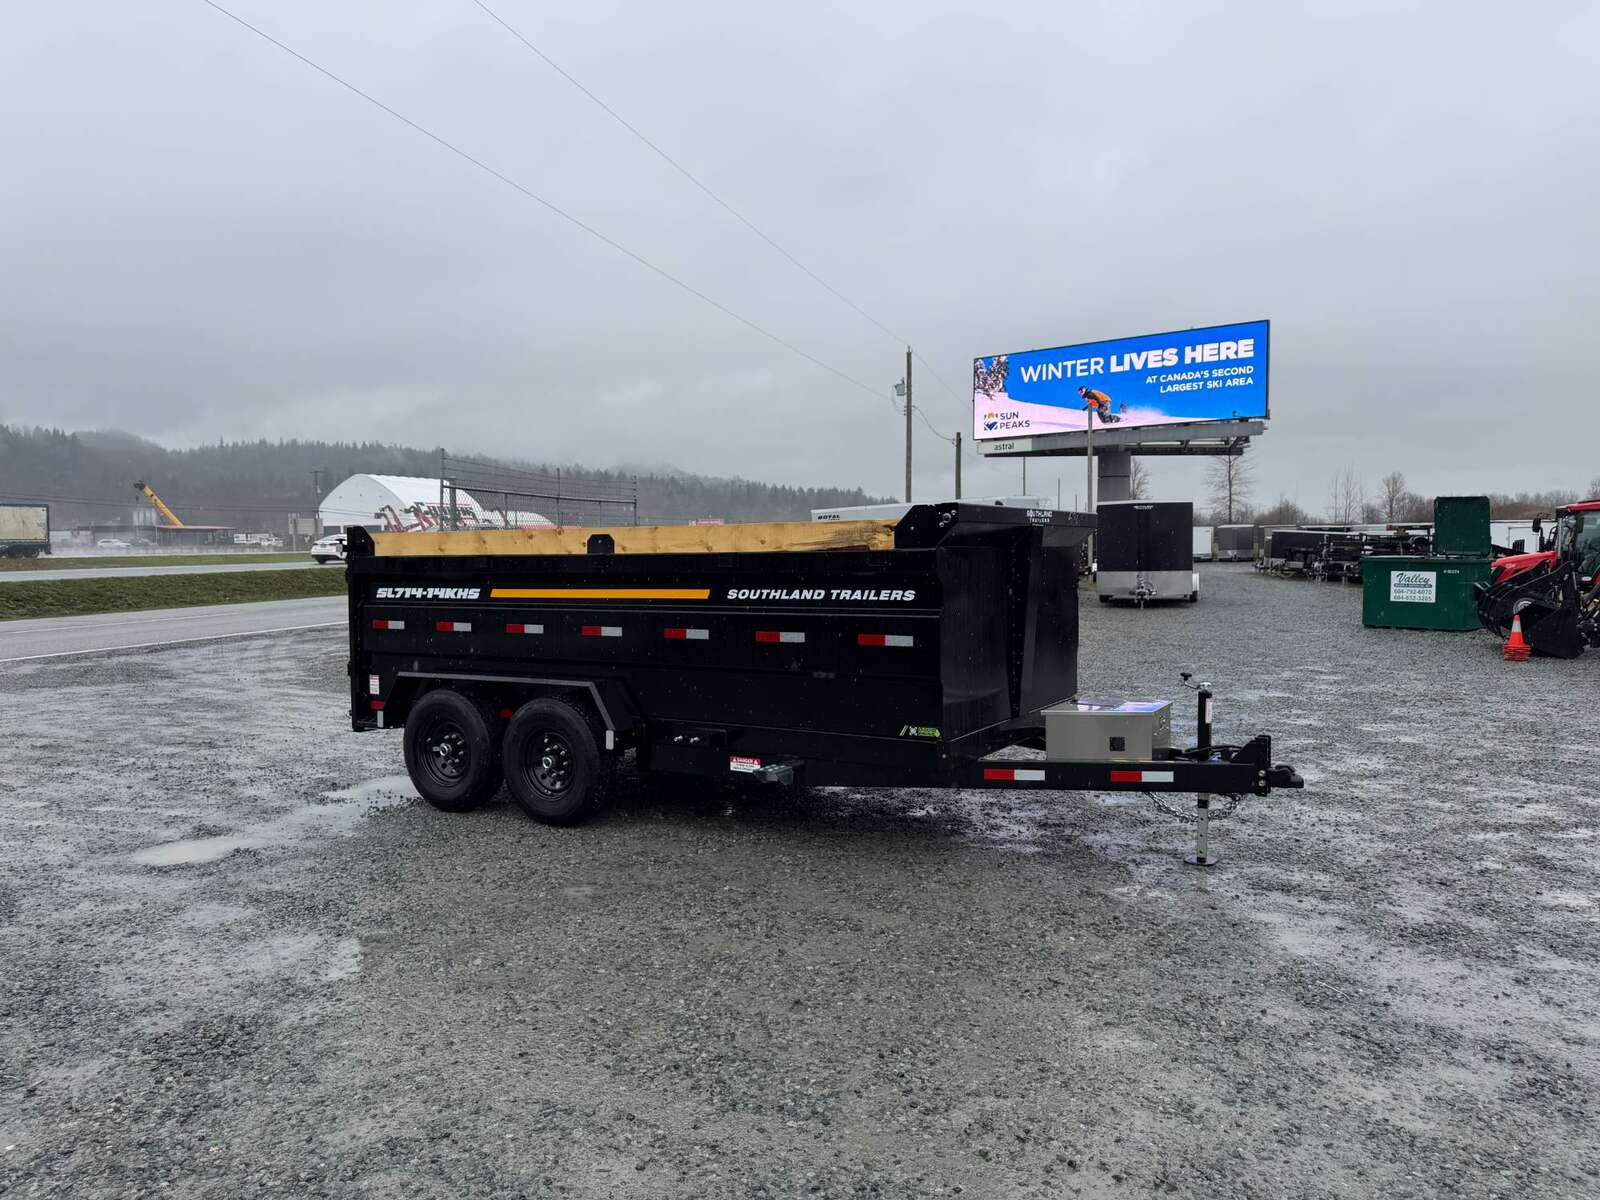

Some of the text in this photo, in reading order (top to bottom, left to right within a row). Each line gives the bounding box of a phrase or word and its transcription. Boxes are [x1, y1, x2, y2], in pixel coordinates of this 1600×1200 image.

[1020, 338, 1254, 384] WINTER LIVES HERE
[1145, 365, 1254, 385] AT CANADA'S SECOND
[1159, 376, 1254, 394] LARGEST SKI AREA
[1000, 411, 1020, 421] SUN
[999, 419, 1031, 430] PEAKS
[993, 441, 1015, 451] astral
[1396, 572, 1432, 584] Valley
[727, 588, 917, 602] SOUTHLAND TRAILERS
